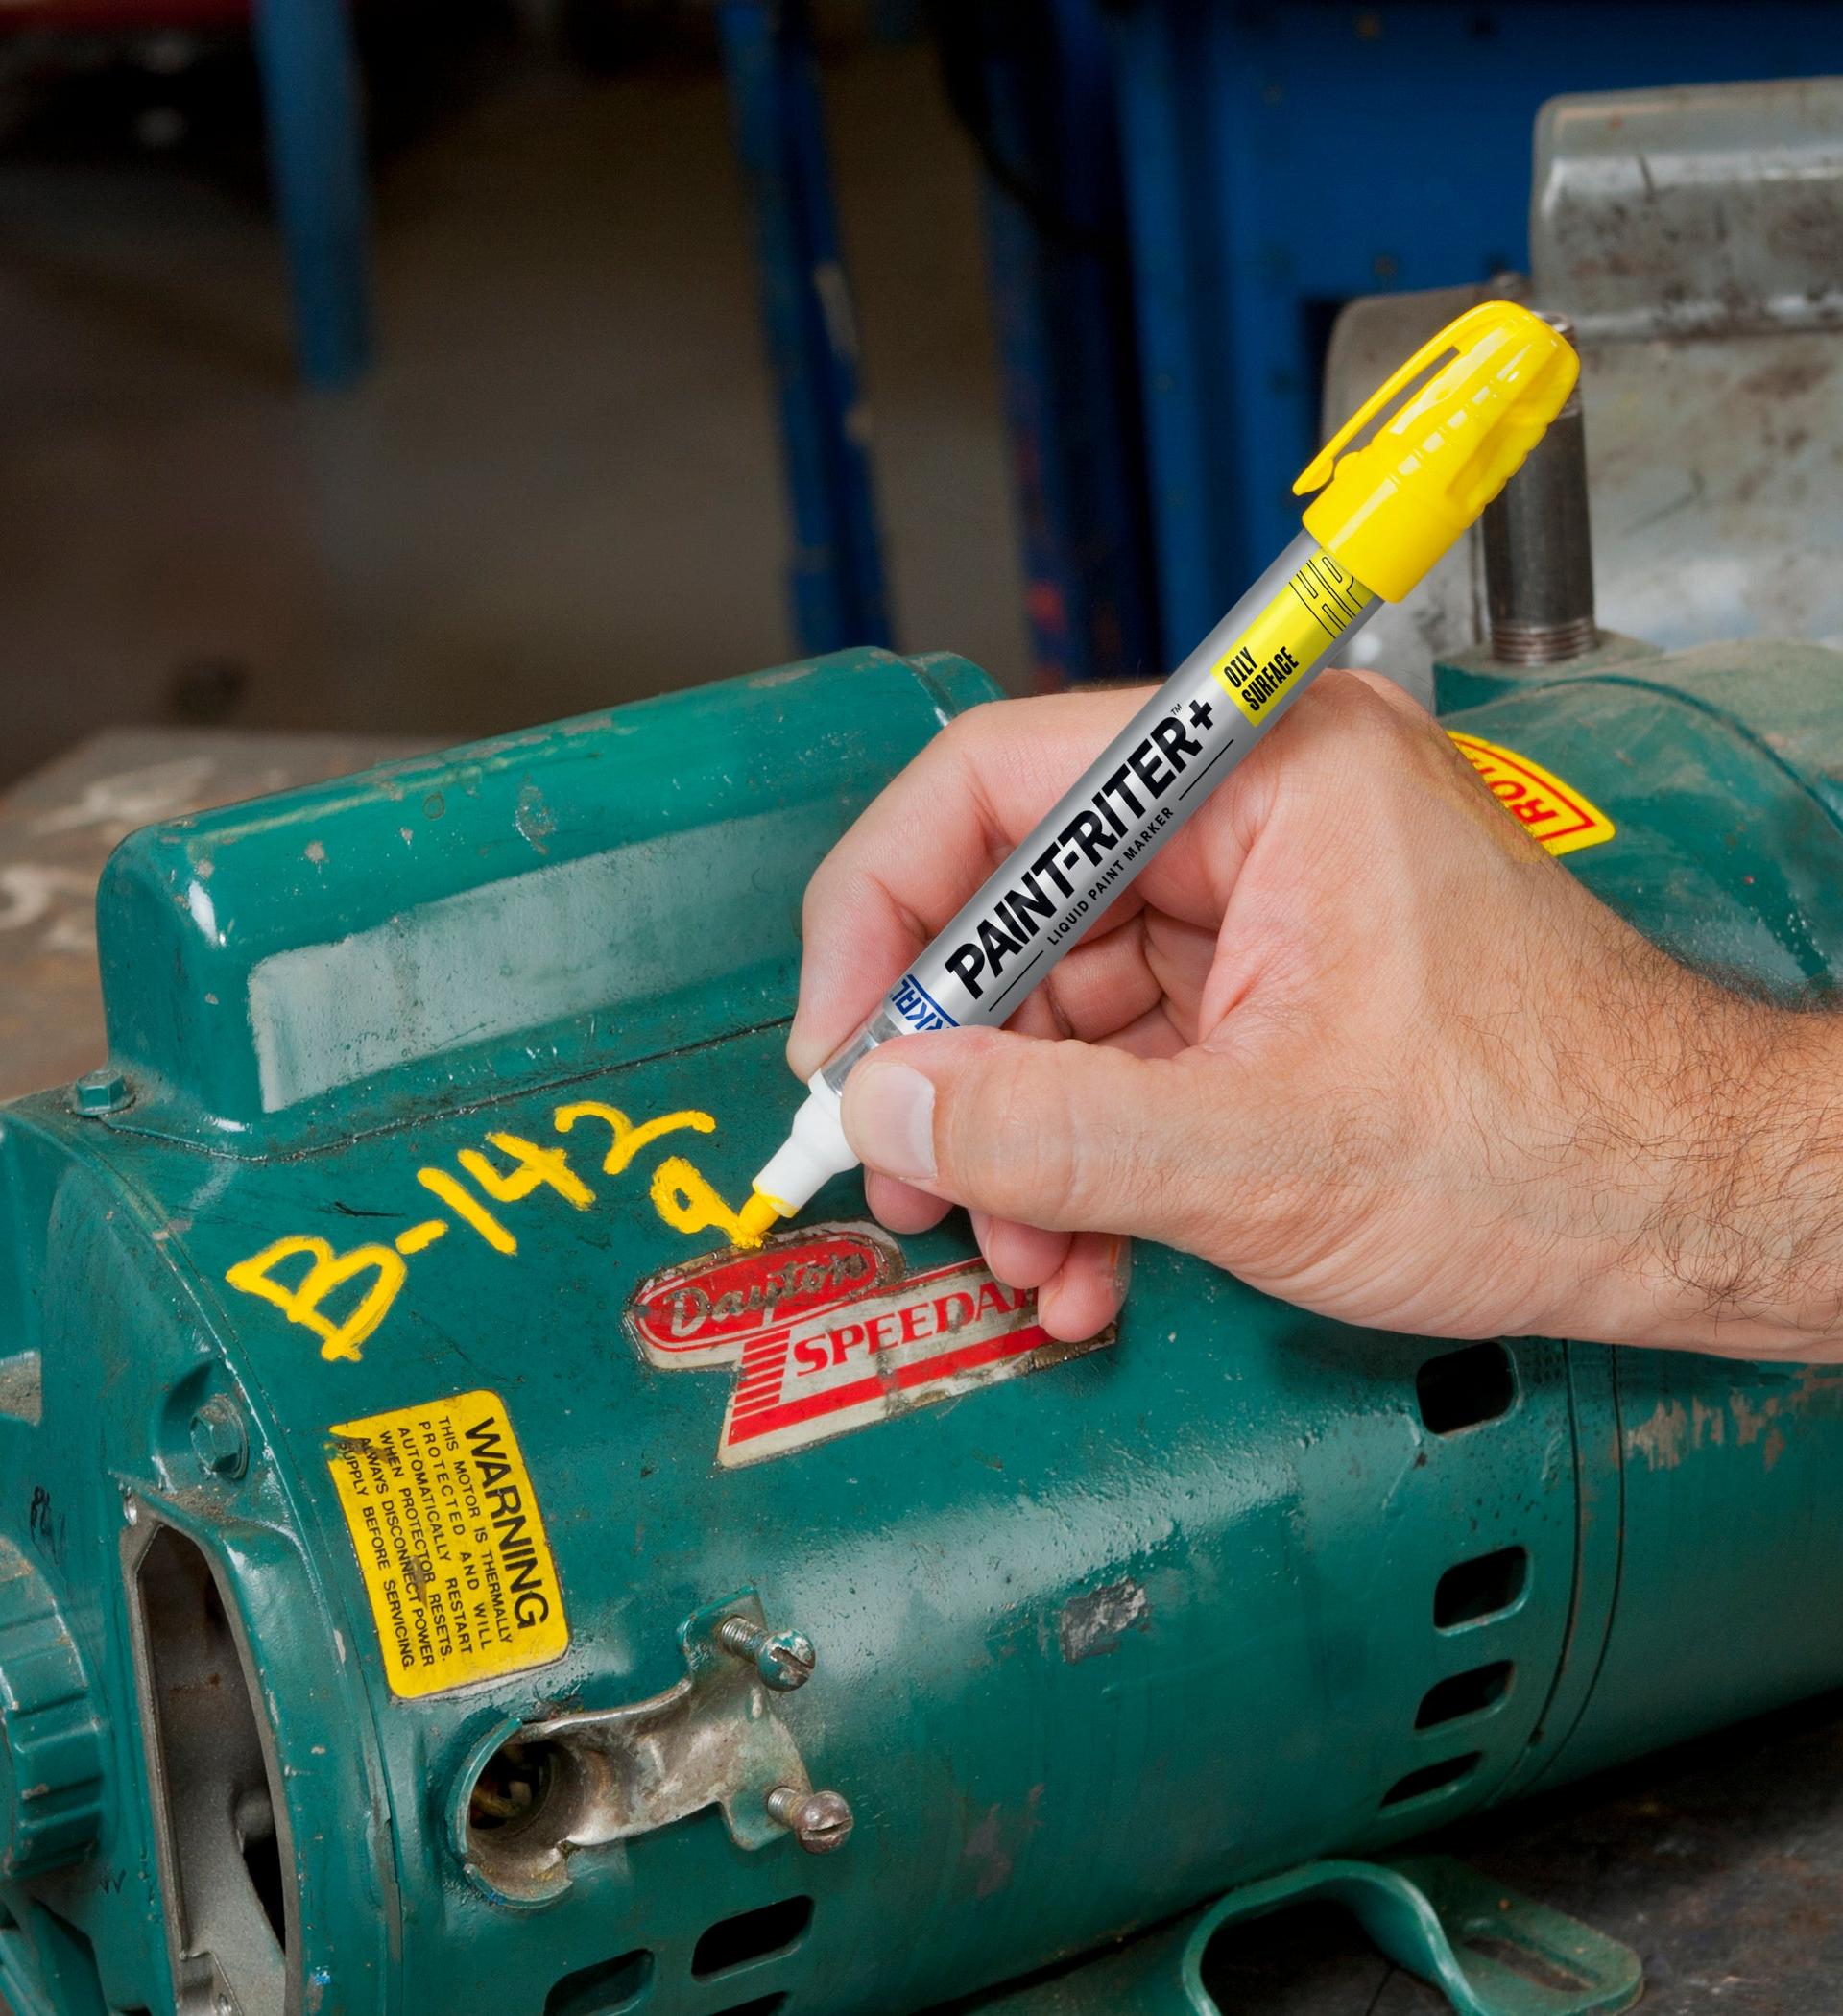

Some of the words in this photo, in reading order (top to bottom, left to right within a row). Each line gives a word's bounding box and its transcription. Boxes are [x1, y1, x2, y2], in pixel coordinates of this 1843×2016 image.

[1223, 646, 1257, 689] OILY
[1241, 645, 1300, 711] SURFACE
[1047, 900, 1089, 946] LIQUID
[1089, 859, 1124, 900] PAINT
[1123, 806, 1174, 861] MARKER
[339, 1442, 369, 1497] SUPPLY
[363, 1506, 391, 1570] BEFORE
[383, 1579, 416, 1672] SERVICING.
[360, 1437, 389, 1495] ALWAYS
[381, 1500, 420, 1602] DISCONNECT
[412, 1607, 435, 1668] POWER
[379, 1429, 404, 1477] WHEN
[398, 1487, 436, 1584] PROTECTOR
[428, 1593, 453, 1662] RESETS.
[398, 1427, 451, 1563] AUTOMATICALLY
[444, 1576, 473, 1655] RESTART
[419, 1420, 466, 1537] PROTECTED
[460, 1550, 480, 1592] AND
[473, 1603, 493, 1650] WILL
[438, 1415, 459, 1452] THIS
[454, 1461, 480, 1519] MOTOR
[474, 1527, 488, 1544] IS
[481, 1549, 513, 1644] THERMALLY
[465, 1416, 550, 1631] WARNING
